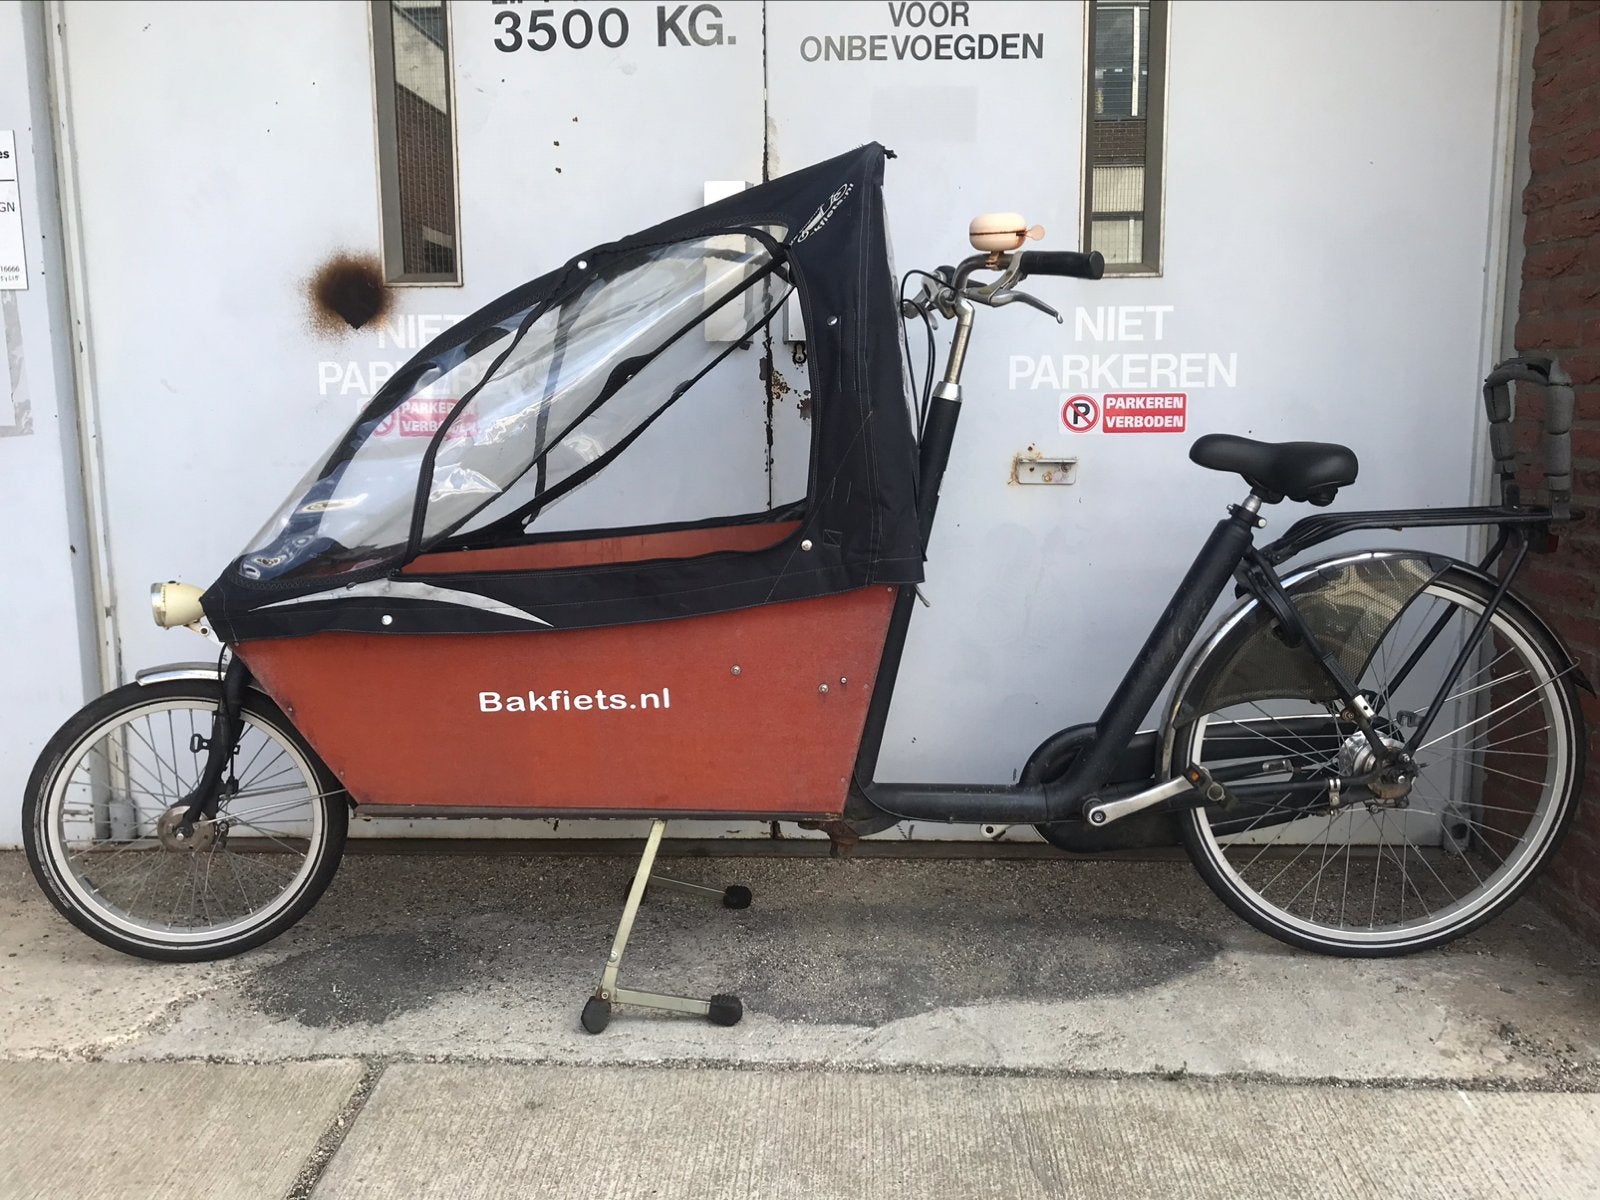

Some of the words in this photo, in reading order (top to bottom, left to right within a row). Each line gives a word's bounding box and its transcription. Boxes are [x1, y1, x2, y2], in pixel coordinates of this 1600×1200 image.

[888, 1, 969, 27] VOOR
[494, 8, 629, 52] 3500
[656, 4, 737, 47] KG.
[800, 33, 1044, 62] ONBEVOEGDEN
[1074, 304, 1175, 342] NIET
[1008, 352, 1238, 390] PARKEREN
[1106, 396, 1184, 410] PARKEREN
[1105, 414, 1184, 429] VERBODEN
[478, 687, 670, 713] Bakfiets.nl
